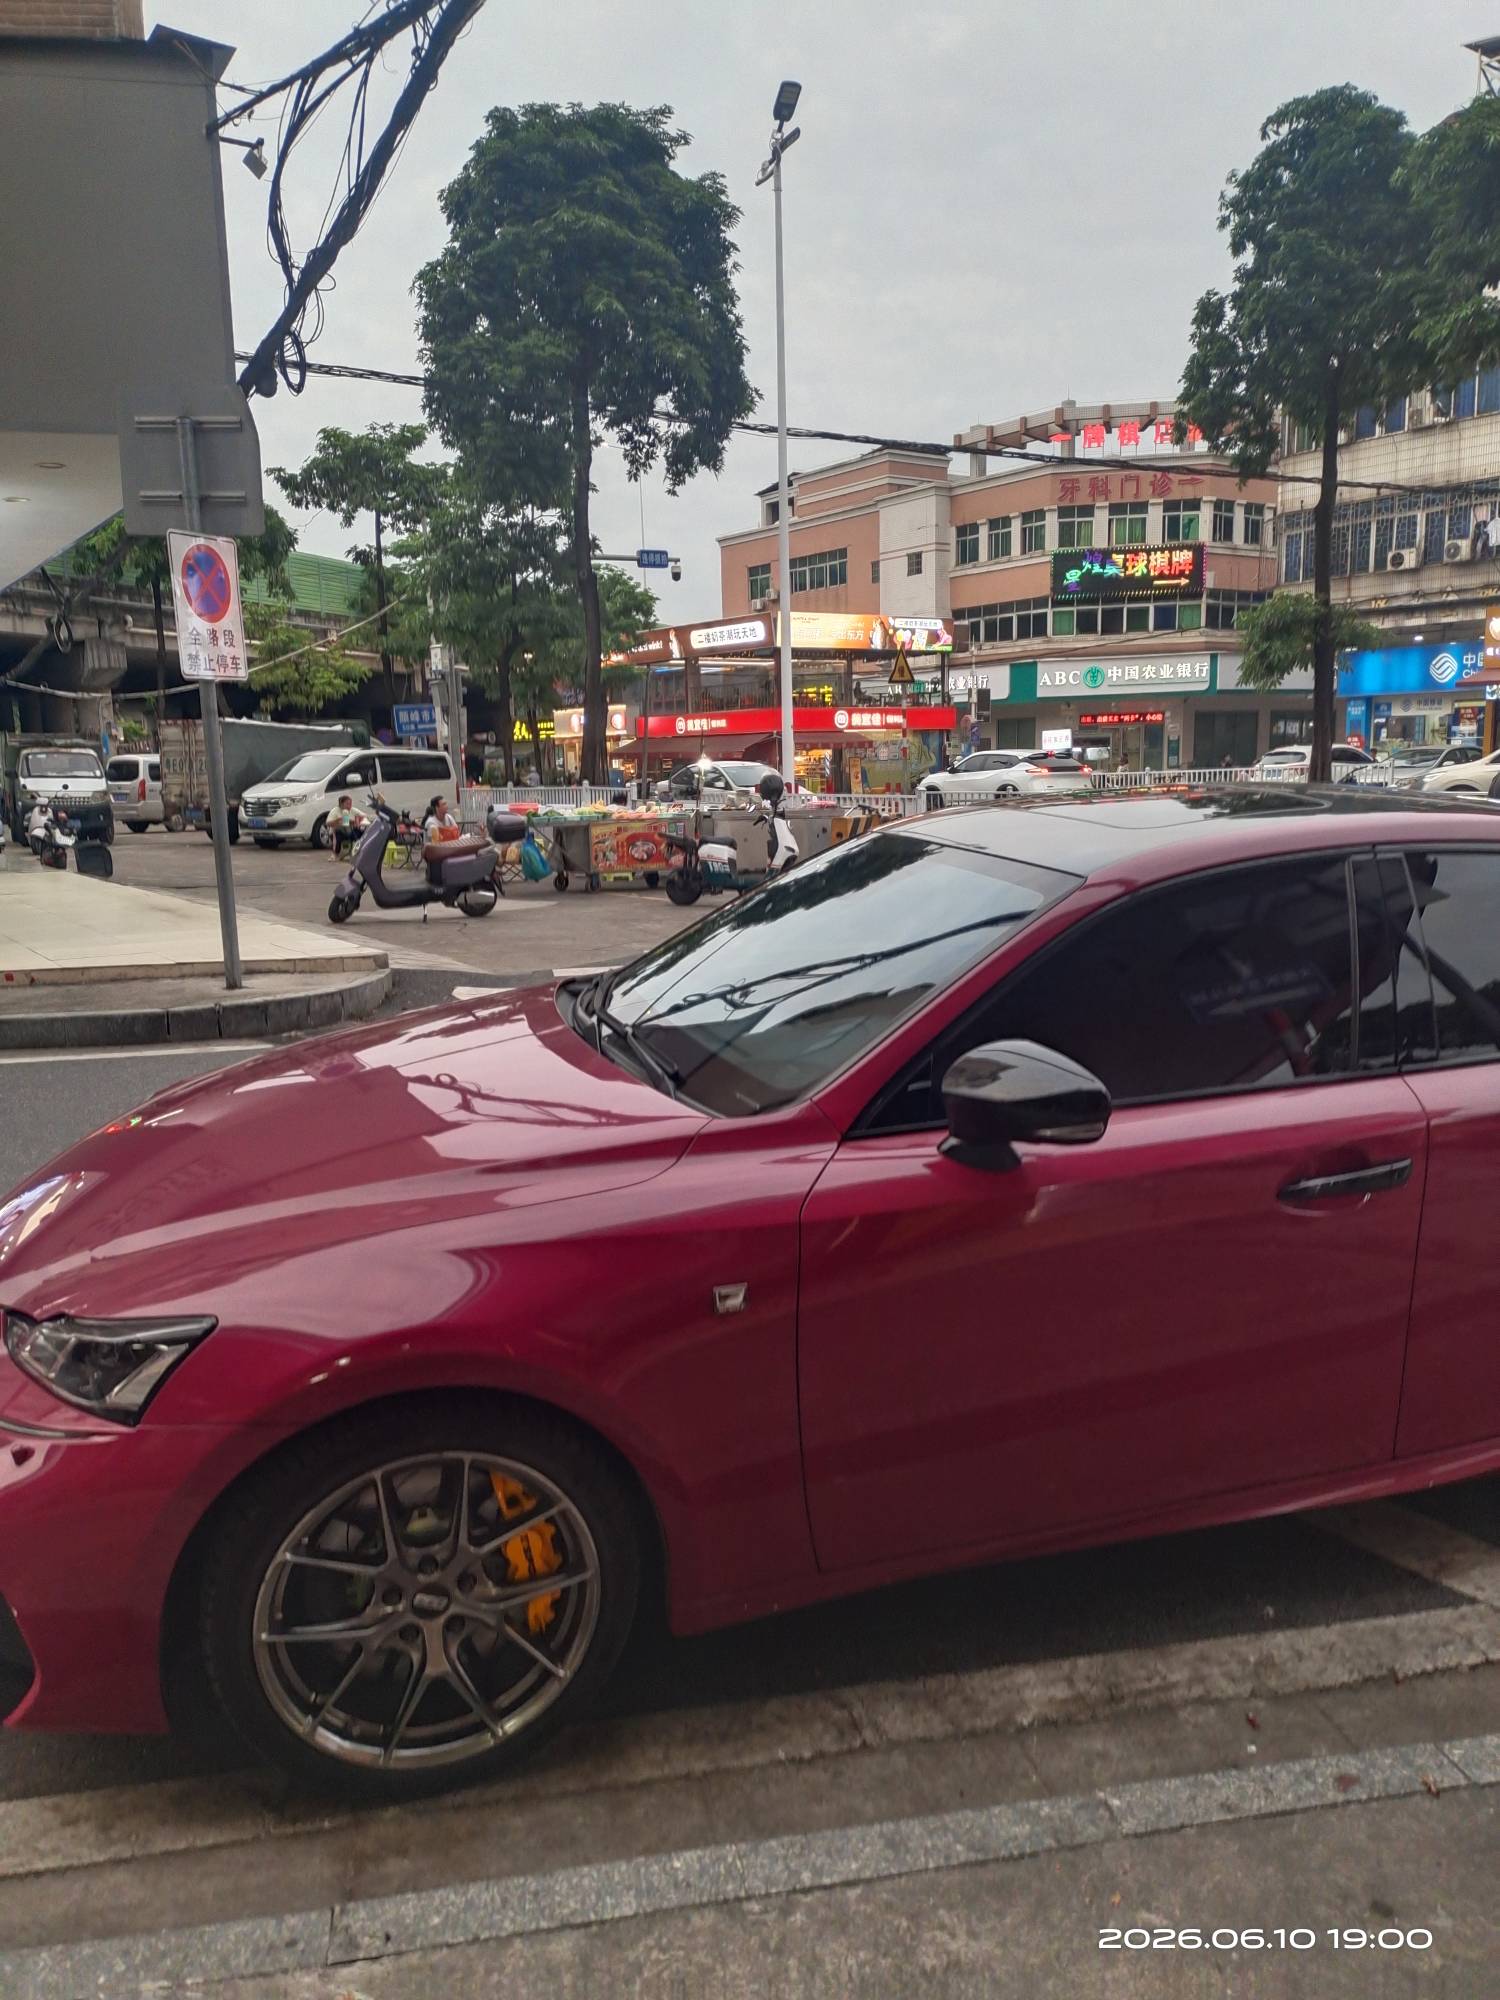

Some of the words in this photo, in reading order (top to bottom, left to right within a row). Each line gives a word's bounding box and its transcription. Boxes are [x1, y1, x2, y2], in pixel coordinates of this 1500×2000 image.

[1058, 472, 1173, 502] 牙科门诊
[189, 627, 236, 647] 全路段
[697, 627, 758, 643] 二楼奶茶潮玩天地
[187, 652, 243, 673] 禁止停车
[1040, 670, 1081, 686] ABC
[1107, 661, 1210, 682] 中国农业银行
